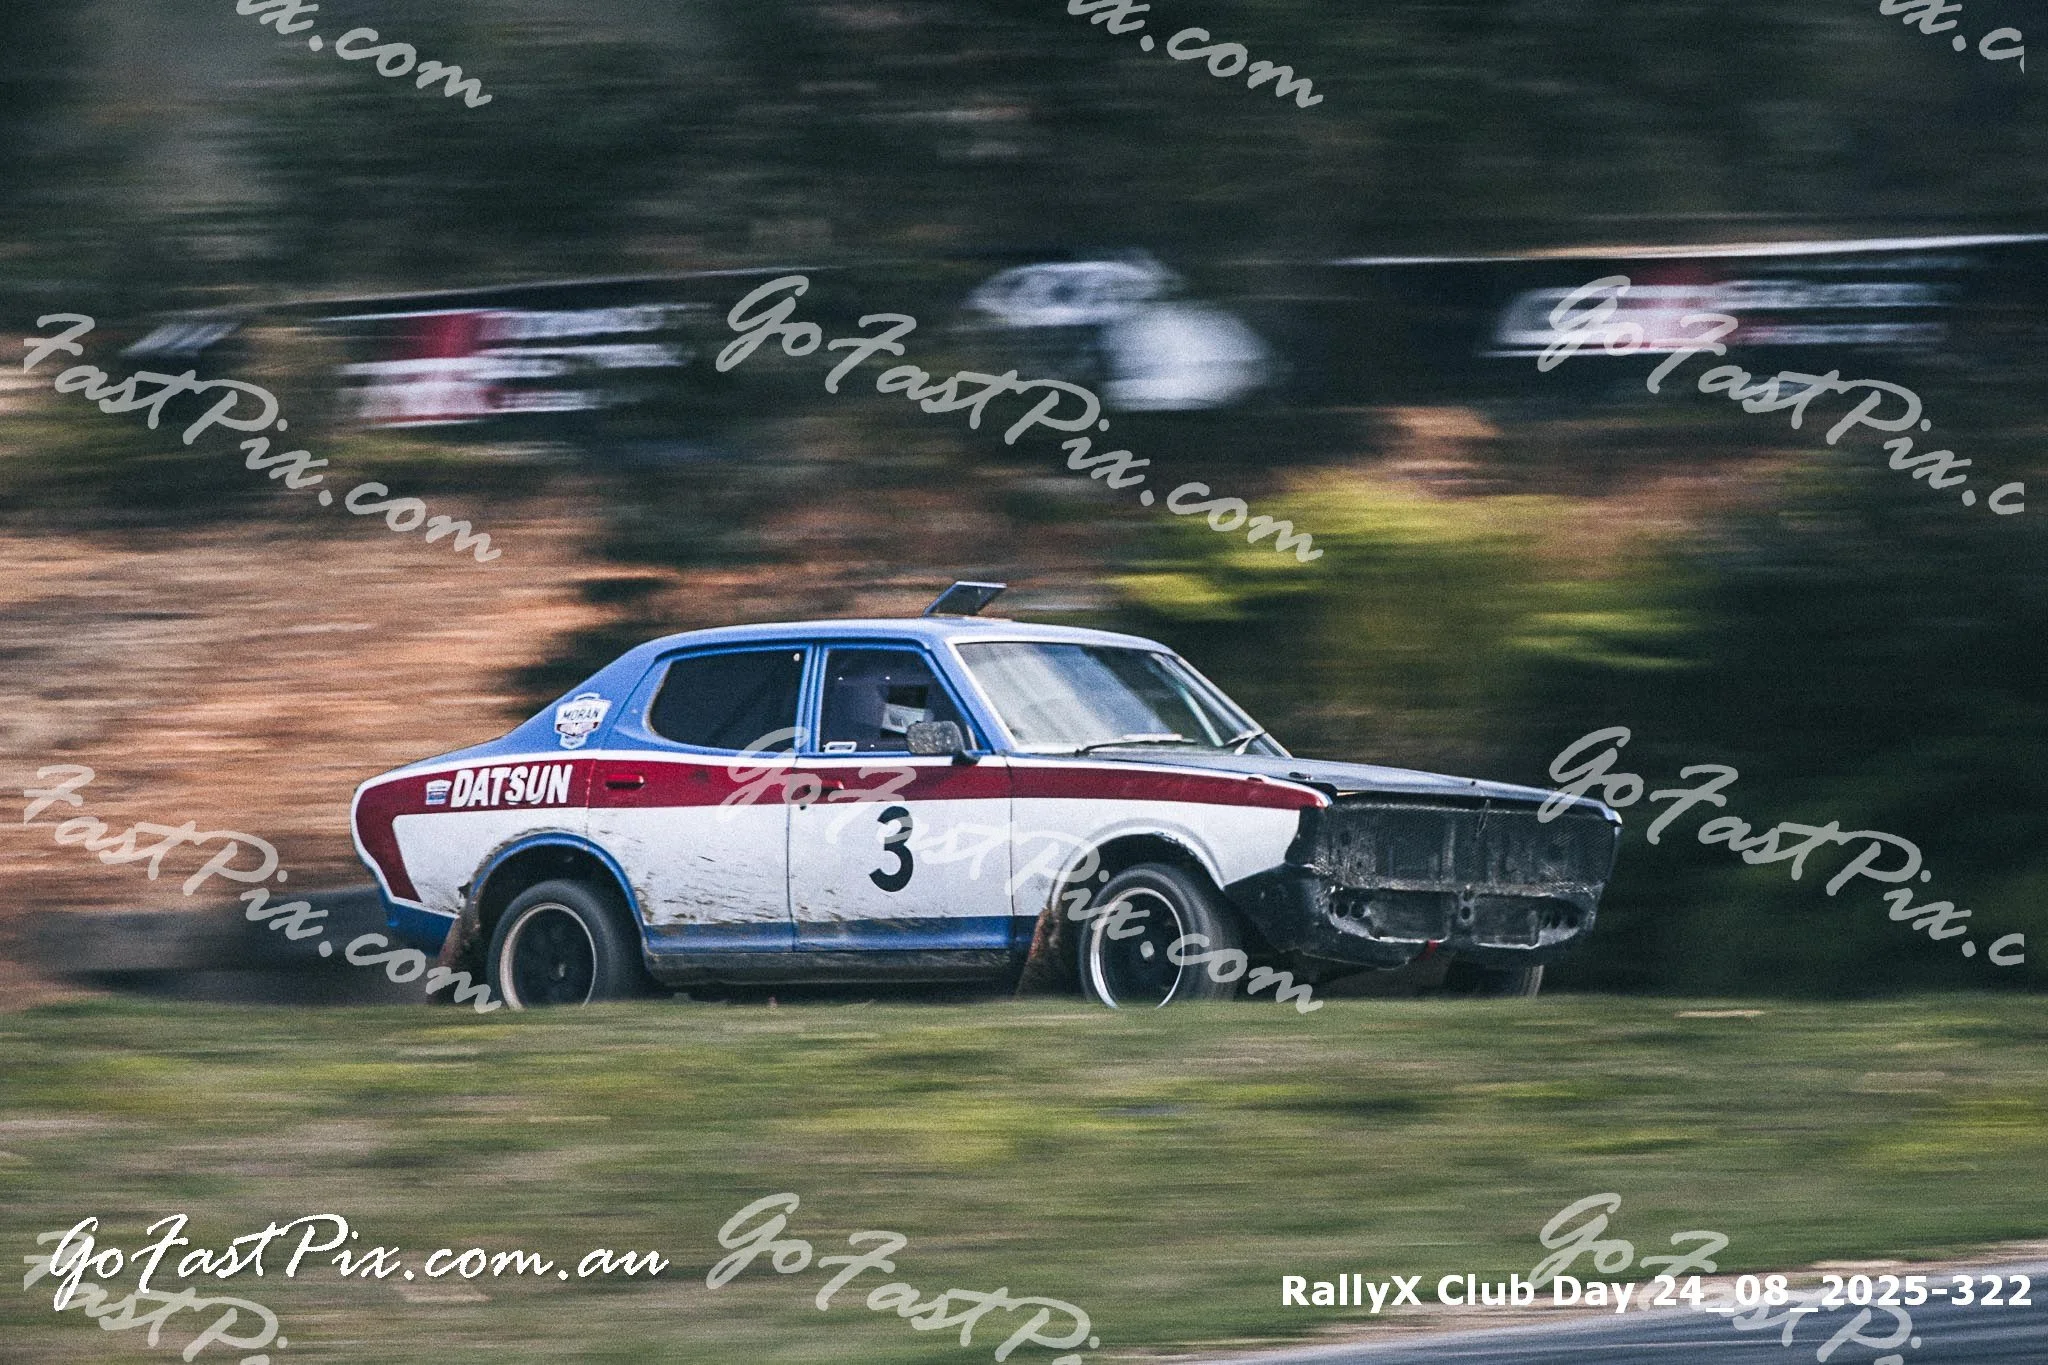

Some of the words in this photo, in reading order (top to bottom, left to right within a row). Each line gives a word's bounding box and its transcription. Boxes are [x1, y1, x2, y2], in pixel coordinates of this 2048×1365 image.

[562, 708, 599, 720] MORAN
[451, 764, 573, 808] DATSUN
[869, 806, 913, 892] 3
